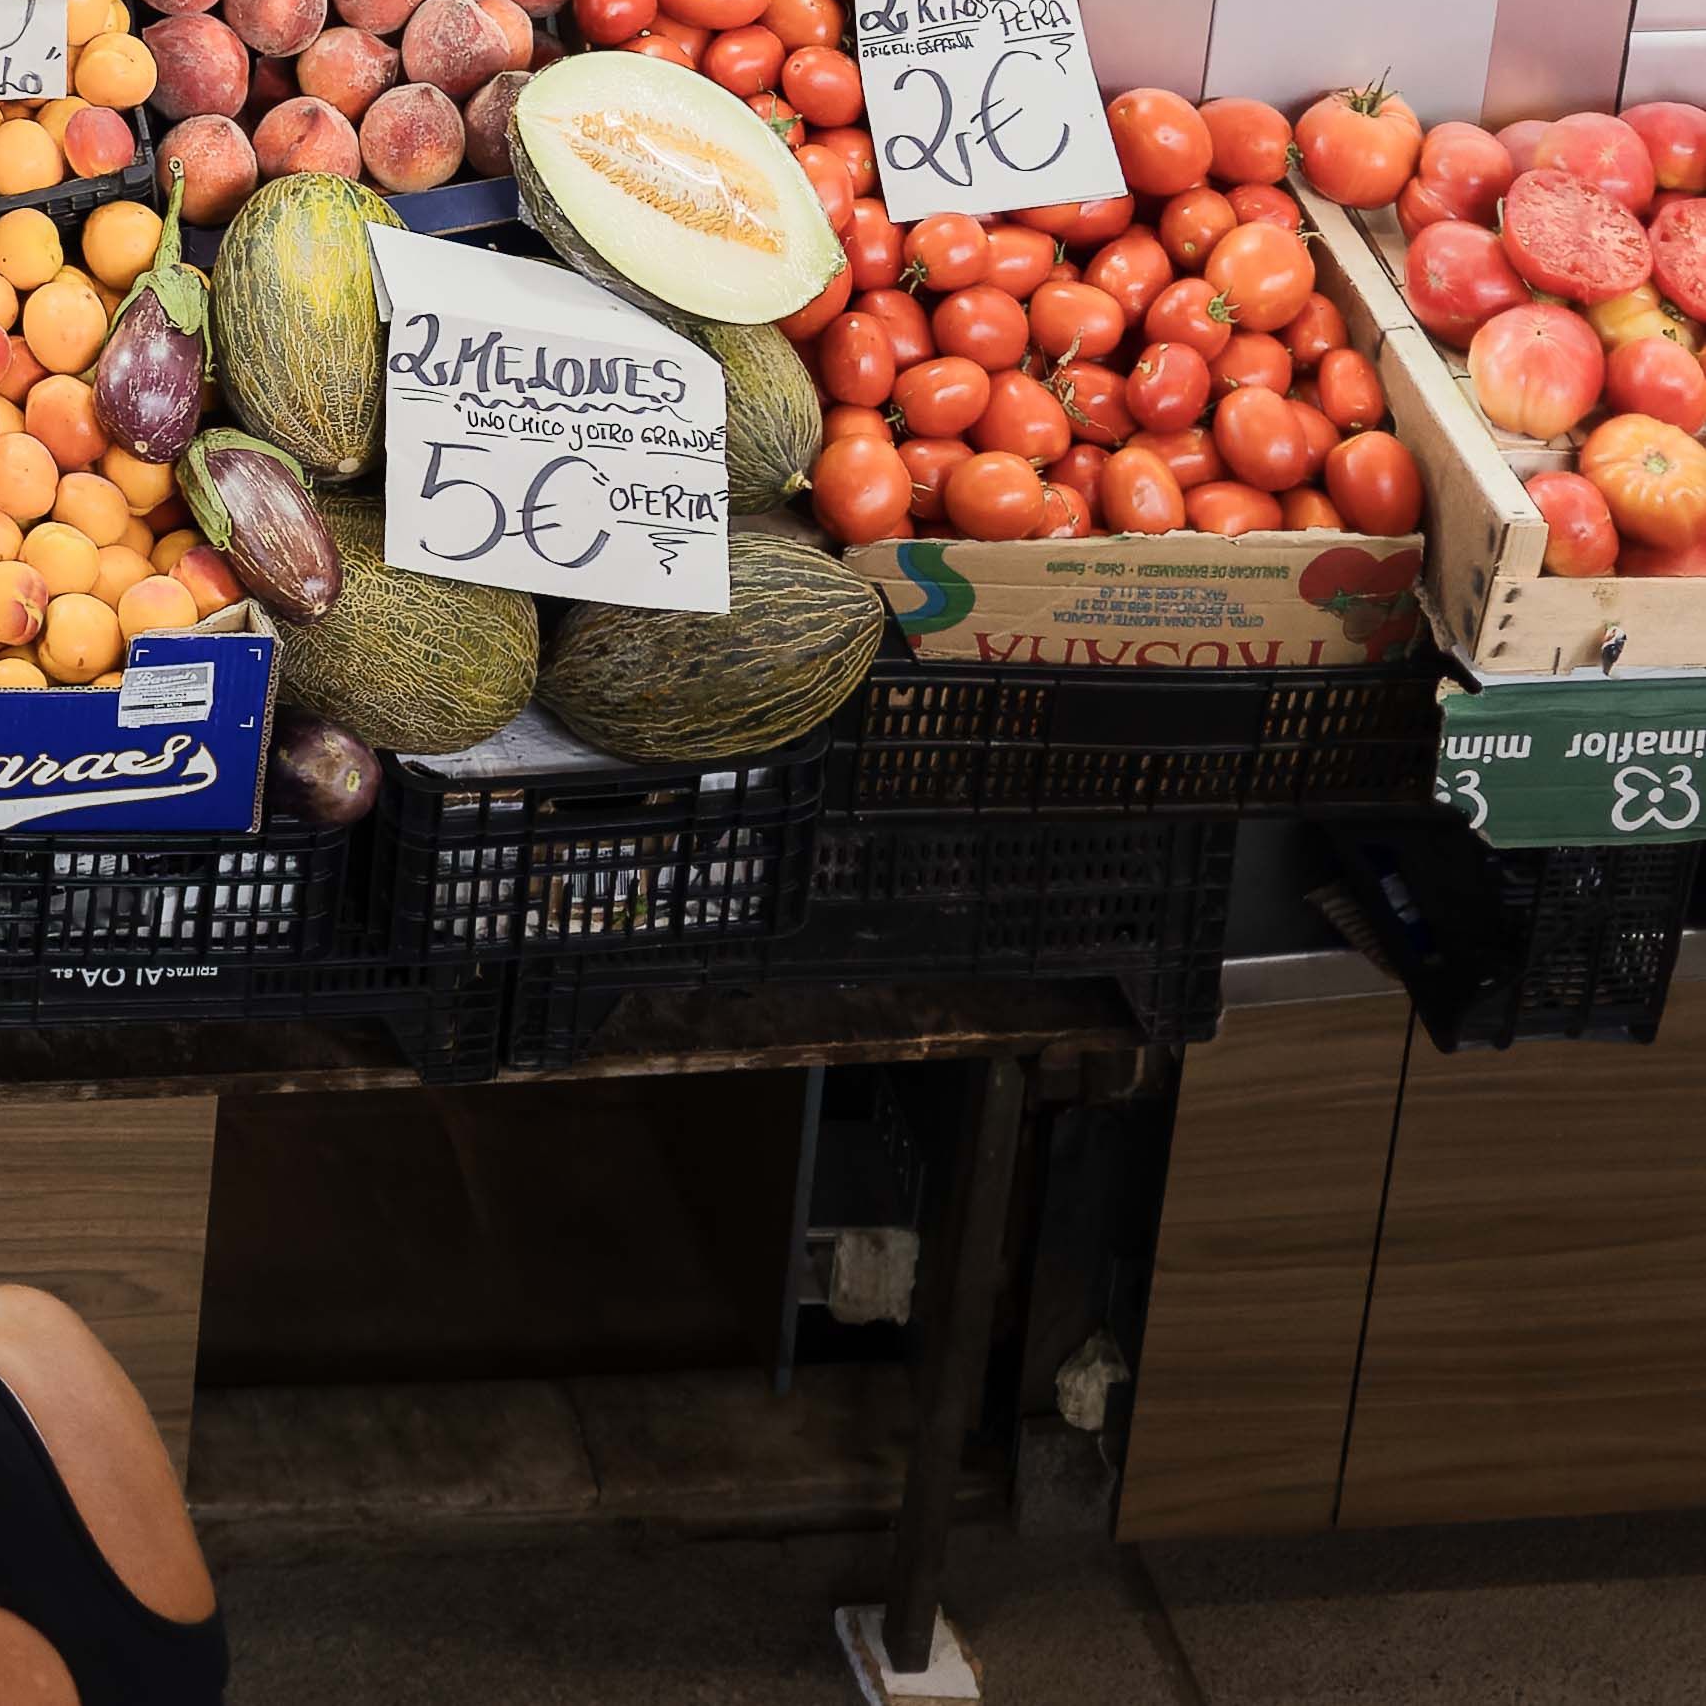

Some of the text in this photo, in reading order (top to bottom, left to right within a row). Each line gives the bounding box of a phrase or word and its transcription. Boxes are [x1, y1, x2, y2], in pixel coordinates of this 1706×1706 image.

[884, 50, 1071, 187] 2€
[389, 313, 687, 404] 2 MELONES
[419, 440, 611, 569] 5€
